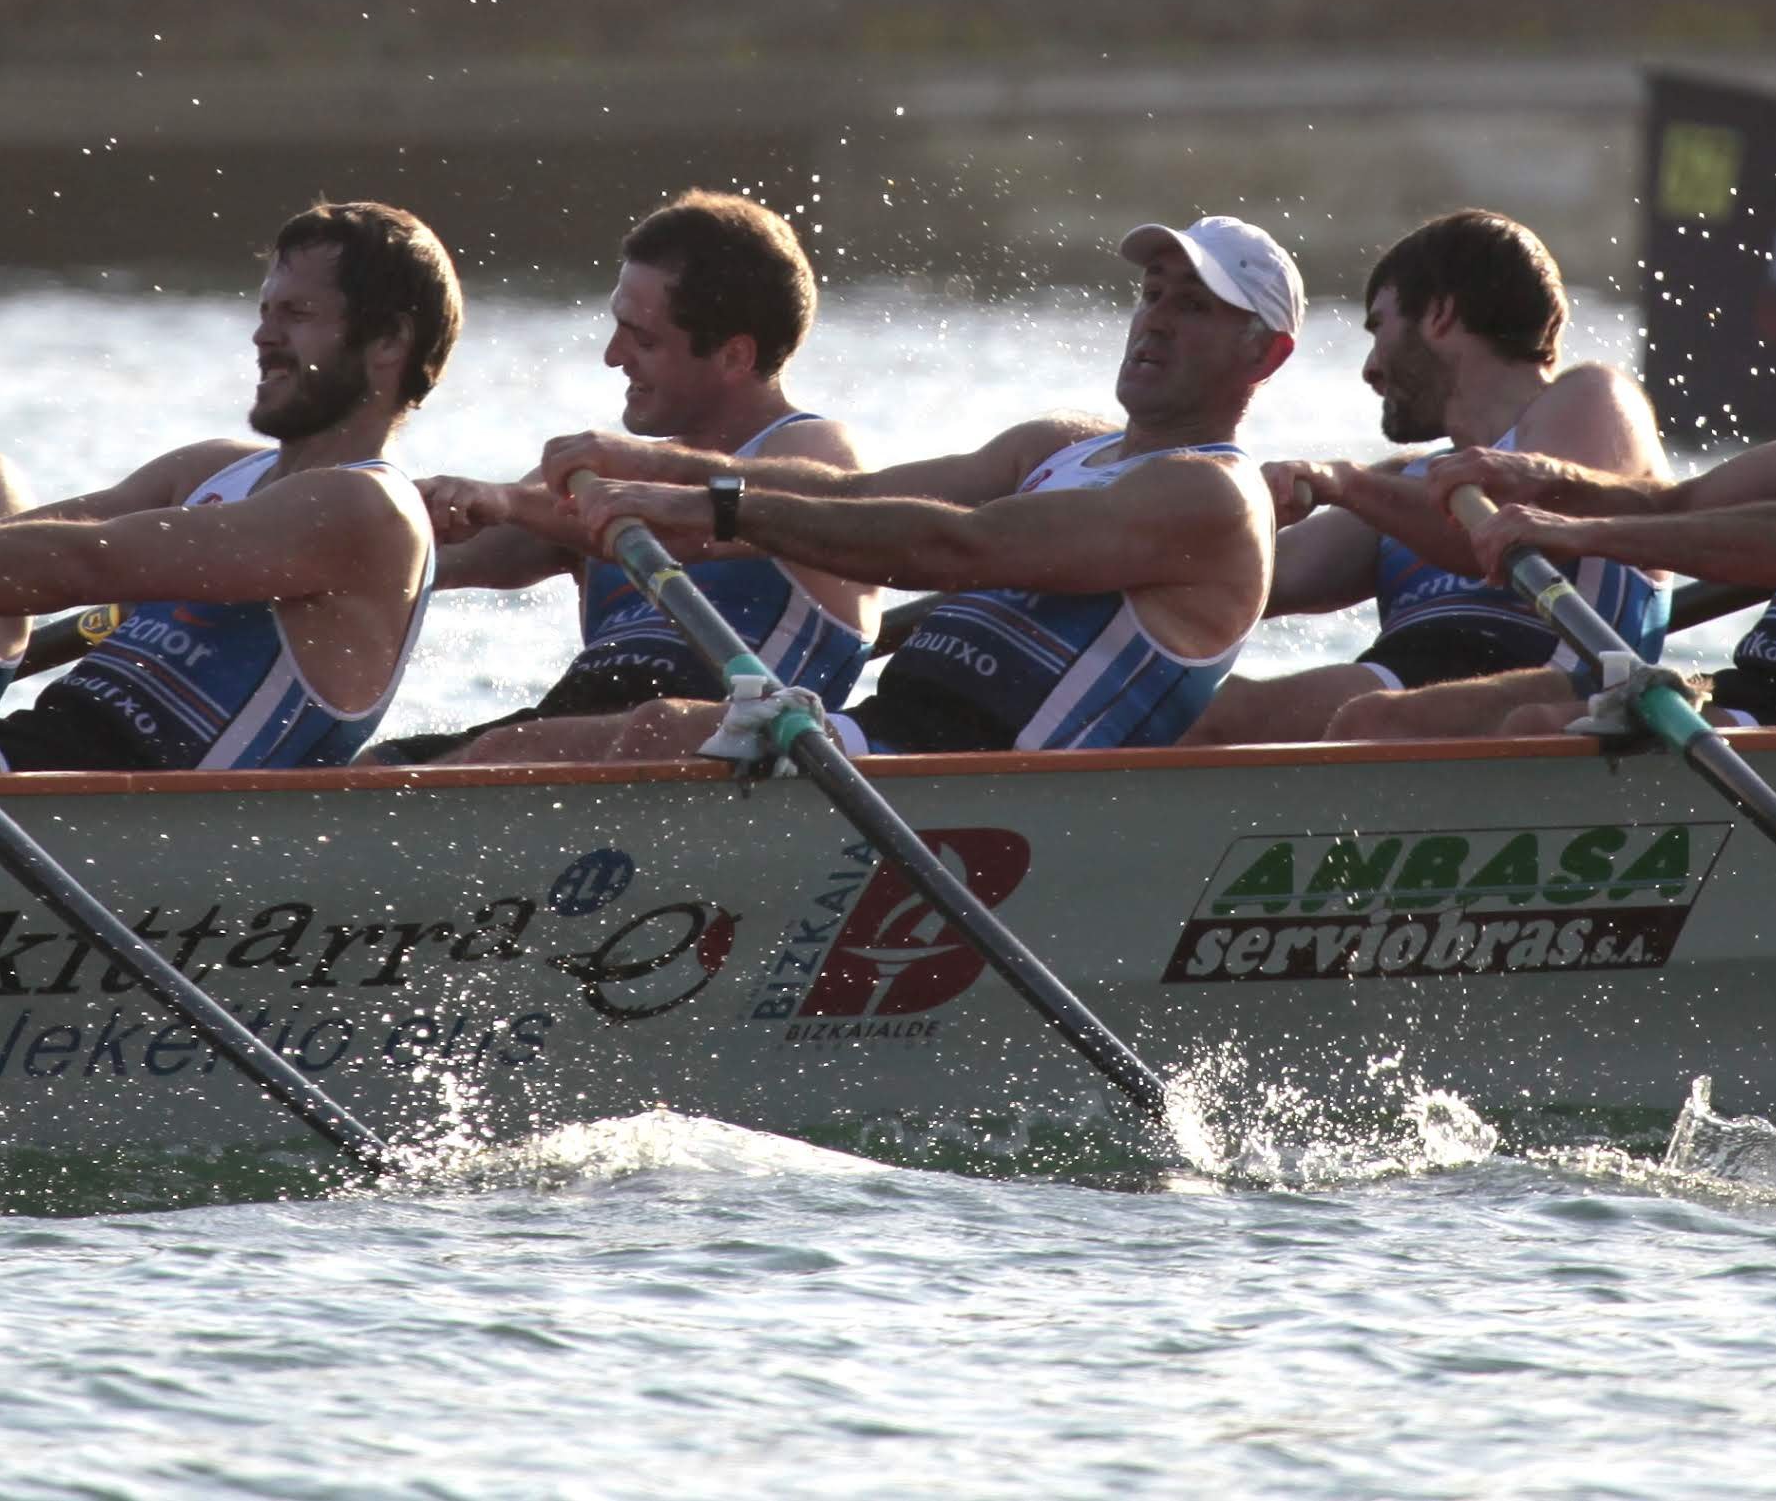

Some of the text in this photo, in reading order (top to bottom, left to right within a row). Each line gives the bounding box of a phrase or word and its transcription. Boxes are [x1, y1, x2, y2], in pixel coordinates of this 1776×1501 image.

[115, 615, 214, 667] ecnor
[1211, 825, 1690, 916] ANBASA
[750, 841, 876, 1020] BIZKAIA
[784, 1019, 941, 1042] BIZKAIALDE
